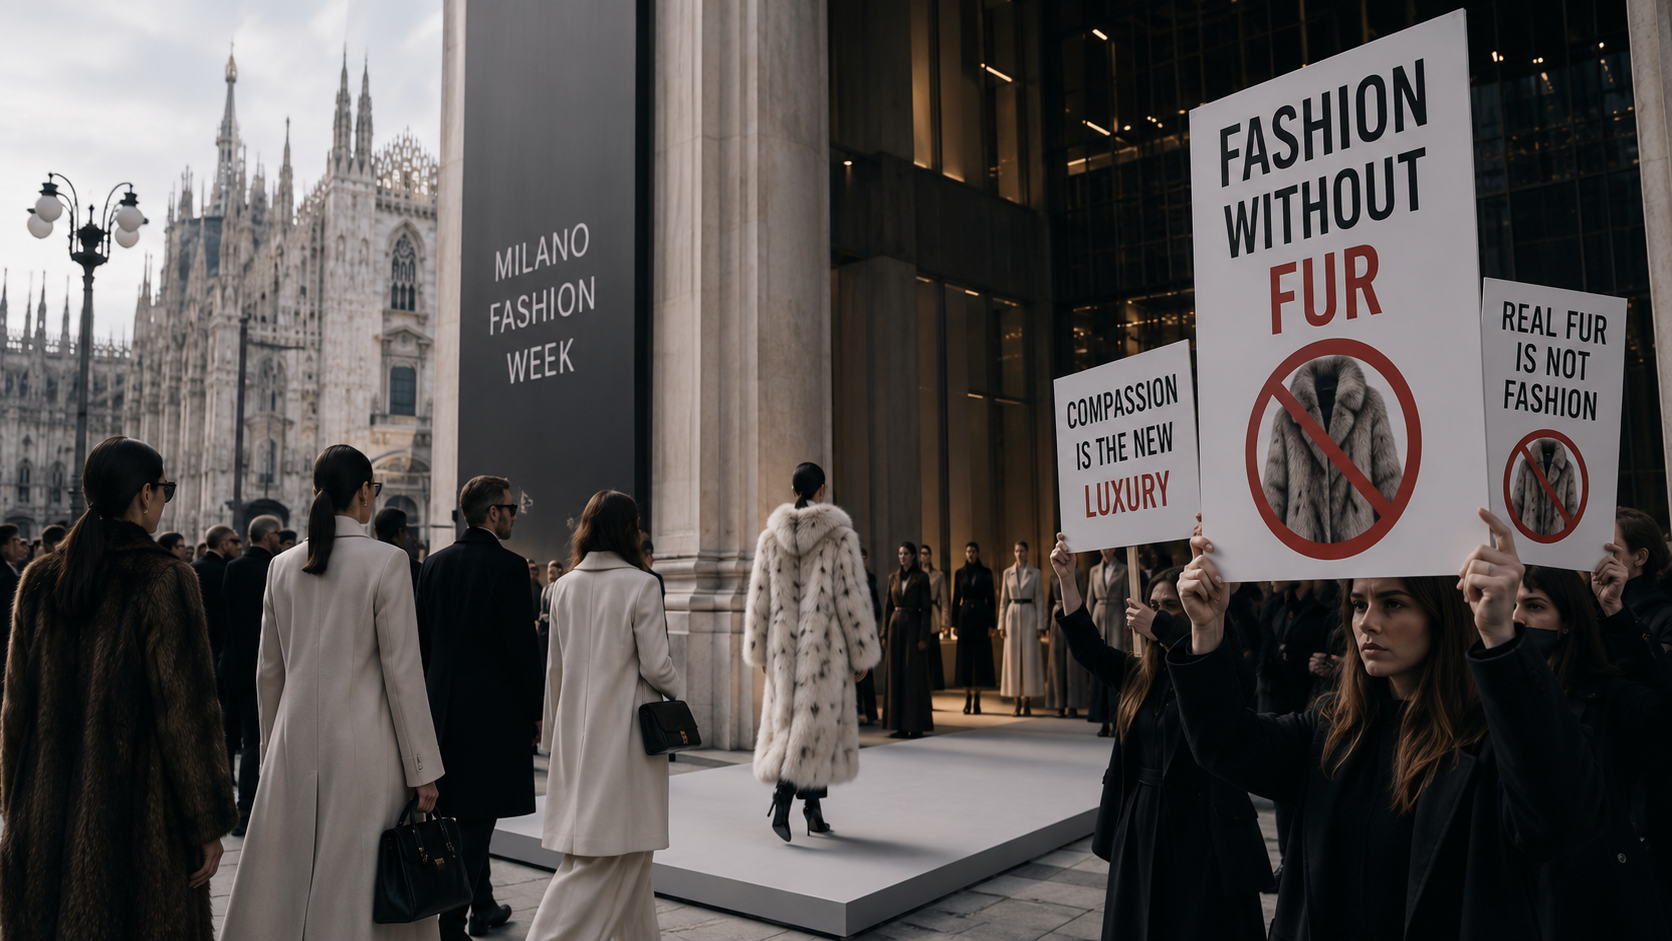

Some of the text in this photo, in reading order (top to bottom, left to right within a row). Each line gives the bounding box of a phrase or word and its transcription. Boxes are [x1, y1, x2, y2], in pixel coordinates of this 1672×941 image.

[1219, 57, 1428, 189] FASHION
[1223, 146, 1427, 259] WITHOUT
[495, 222, 590, 283] MILANO
[489, 275, 596, 336] FASHION
[1269, 244, 1383, 336] FUR
[1501, 300, 1608, 346] REAL FUR
[506, 337, 575, 384] WEEK
[1515, 341, 1591, 381] IS NOT
[1066, 373, 1179, 430] COMPASSION
[1503, 378, 1598, 422] FASHION
[1075, 421, 1173, 471] IS THE NEW
[1084, 469, 1170, 519] LUXURY
